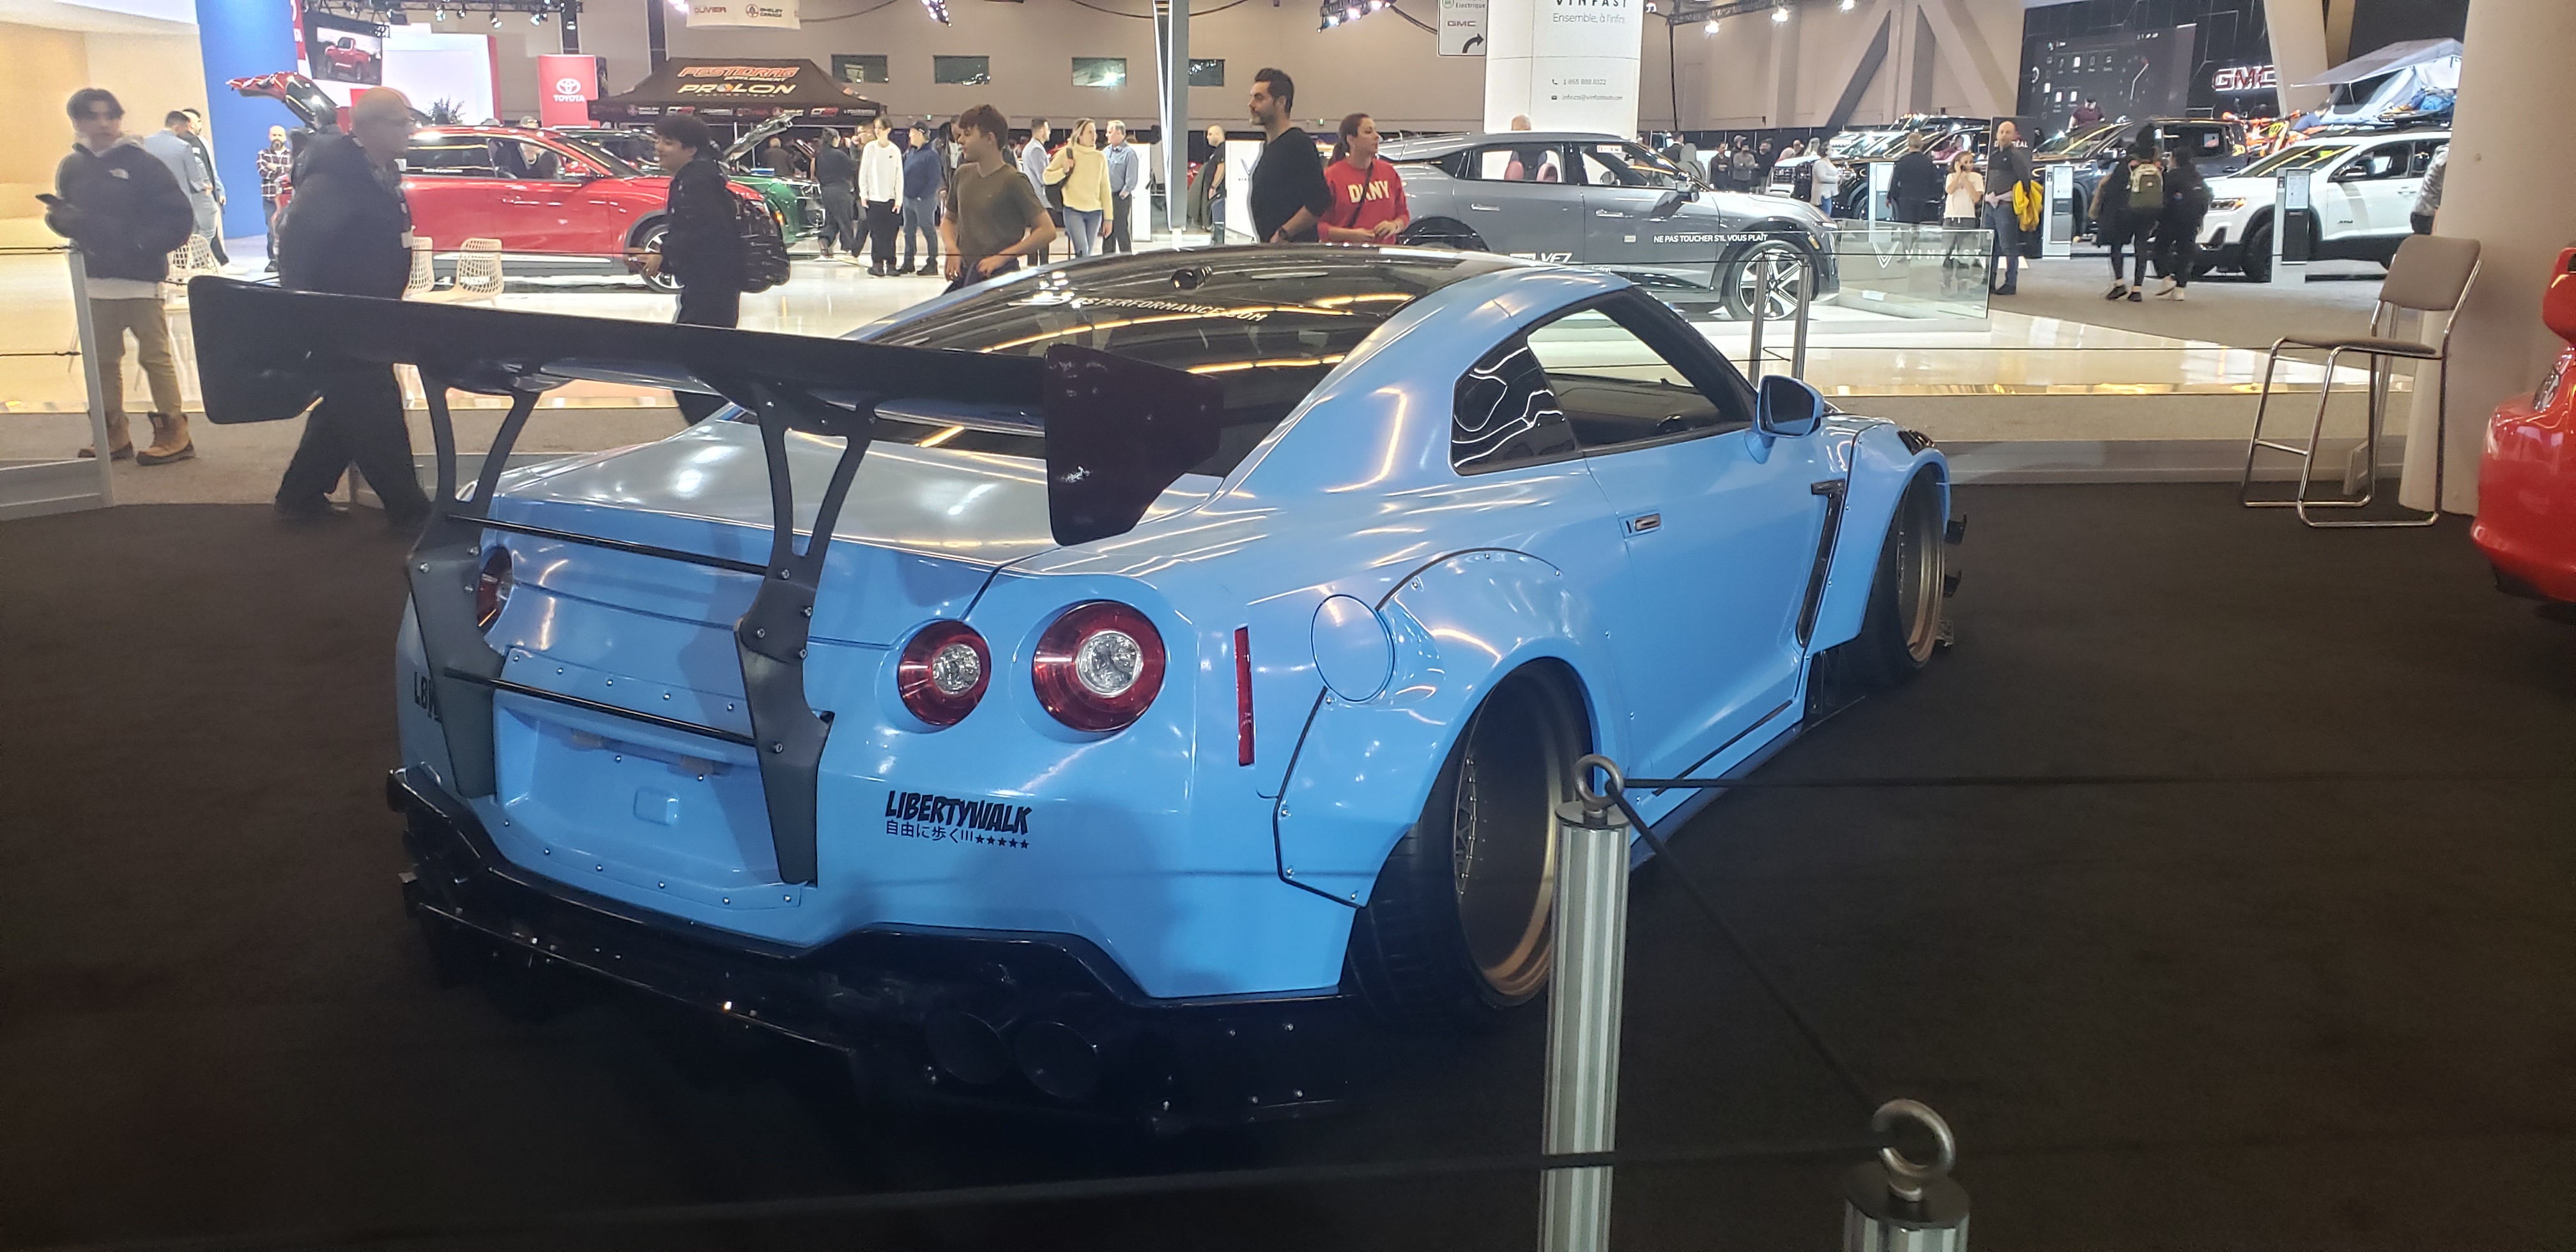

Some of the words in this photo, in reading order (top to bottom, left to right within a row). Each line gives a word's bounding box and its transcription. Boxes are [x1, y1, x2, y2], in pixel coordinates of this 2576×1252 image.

[2212, 64, 2278, 92] GMC
[677, 83, 797, 95] PROLON
[553, 94, 586, 102] TOYOTA
[1680, 234, 1713, 243] TOUCHER
[1727, 234, 1747, 242] VOUS
[885, 790, 1032, 836] LIBERTYWALK
